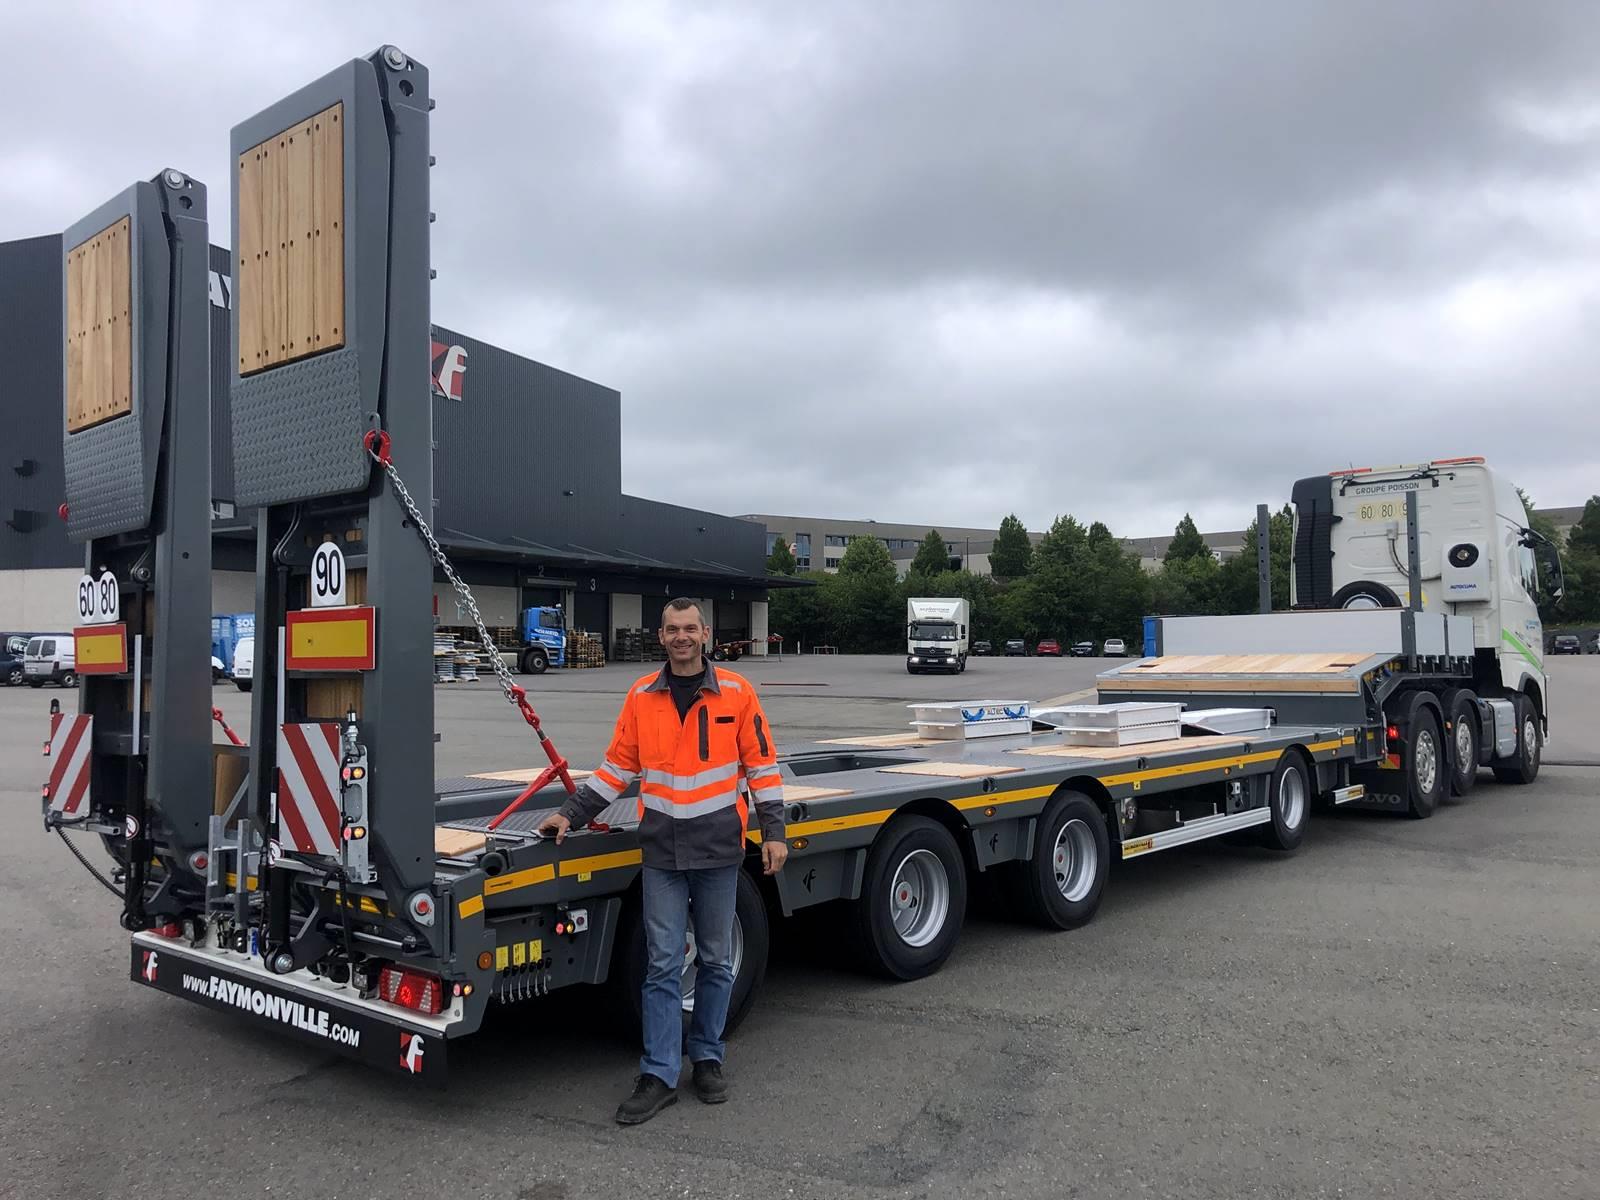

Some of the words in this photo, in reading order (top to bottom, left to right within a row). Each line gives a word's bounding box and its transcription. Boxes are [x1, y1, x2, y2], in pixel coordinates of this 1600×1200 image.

[1355, 485, 1386, 495] GROUPE
[1388, 482, 1420, 491] POISSON
[1361, 505, 1373, 519] 60
[1381, 504, 1393, 518] 80
[316, 550, 341, 598] 90
[538, 565, 544, 577] 2
[590, 578, 596, 591] 3
[664, 584, 669, 596] 4
[79, 582, 95, 616] 60
[100, 578, 116, 615] 80
[730, 589, 735, 600] 5
